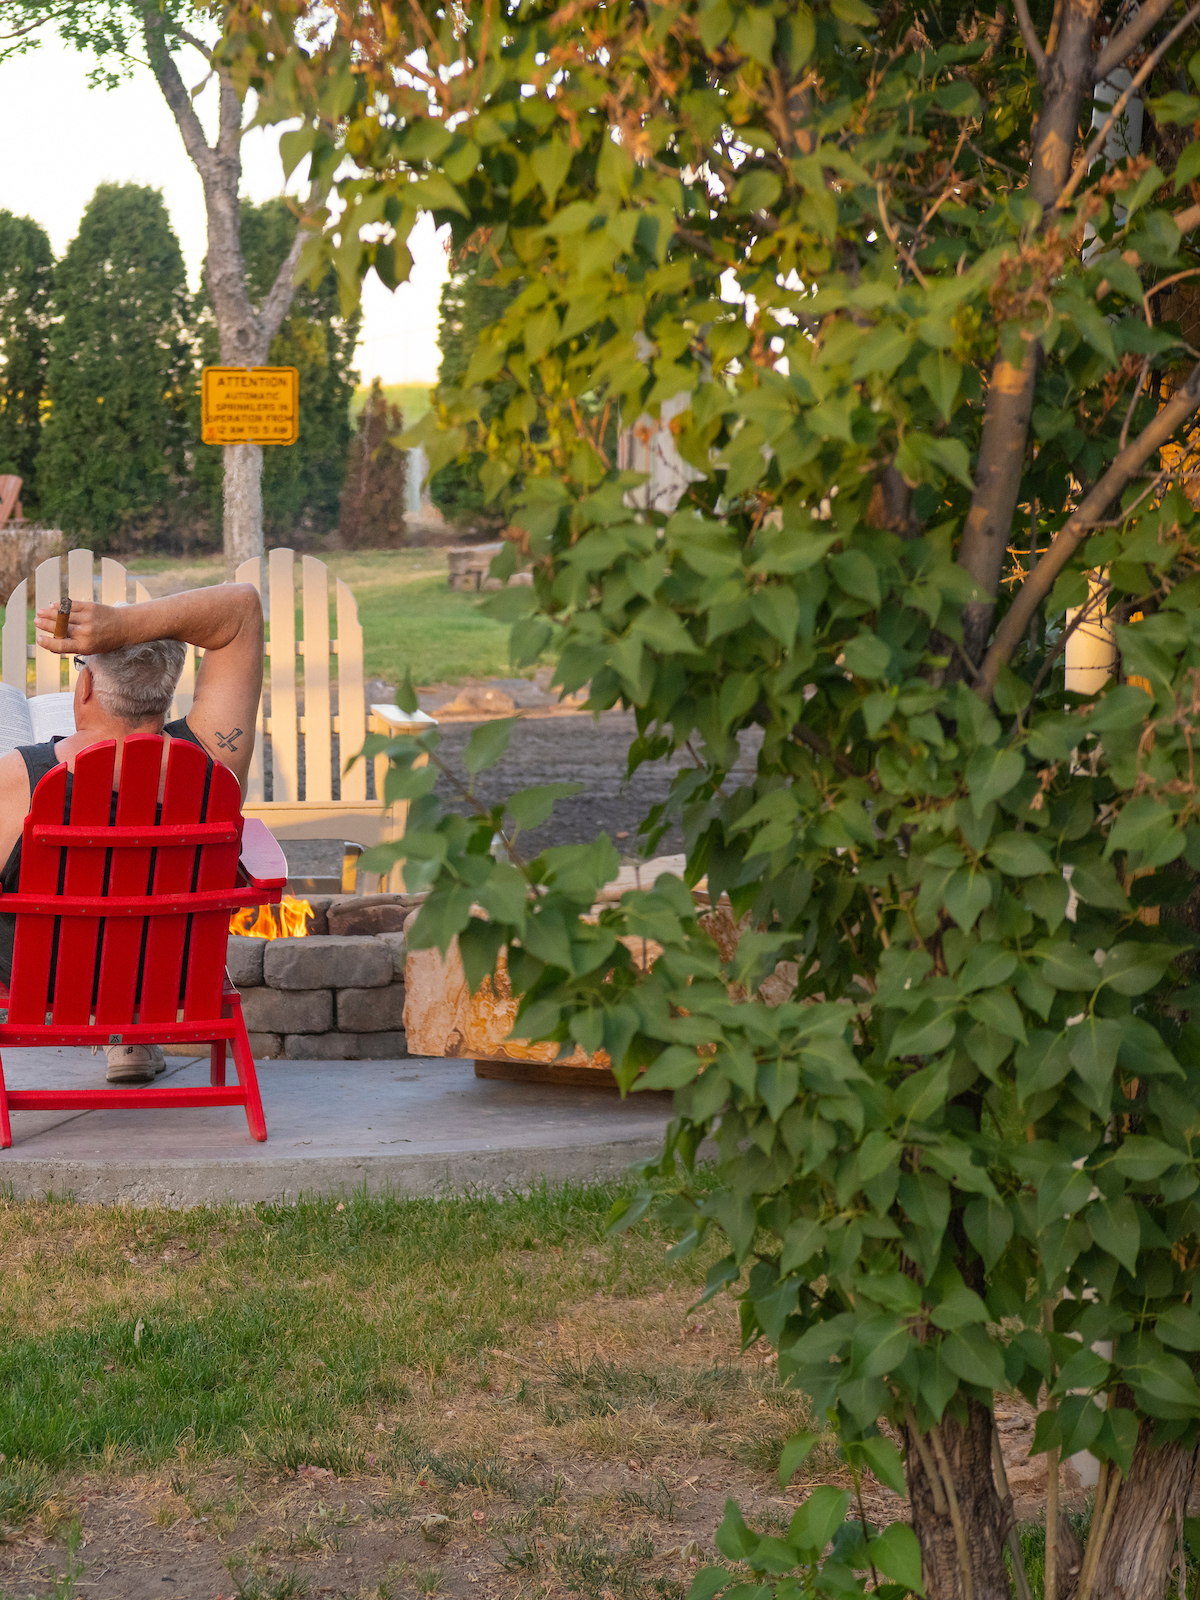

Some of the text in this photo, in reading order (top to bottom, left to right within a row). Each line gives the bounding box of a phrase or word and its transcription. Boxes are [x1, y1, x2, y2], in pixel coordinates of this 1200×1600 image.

[217, 377, 288, 387] ATTENTION
[225, 392, 280, 400] AUTOMATIC
[216, 403, 275, 411] SPRINKLERS
[209, 414, 262, 423] OPERATION
